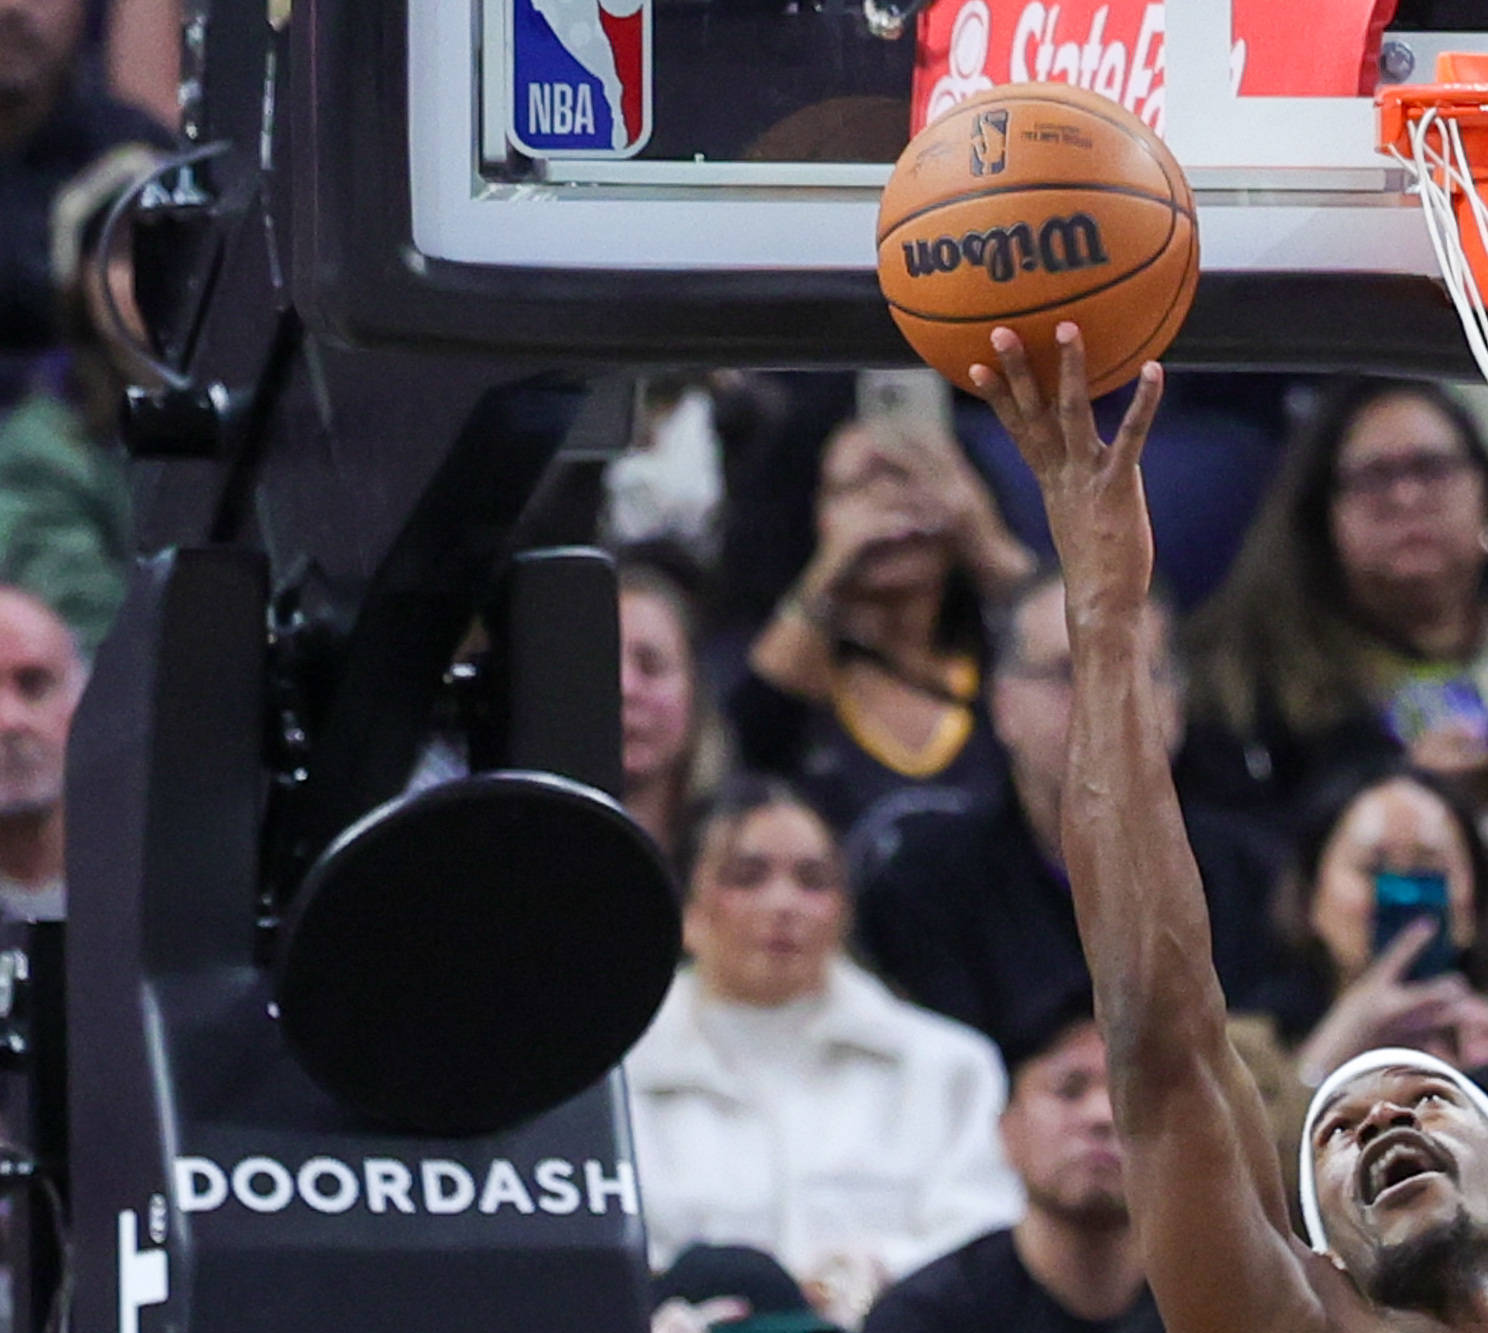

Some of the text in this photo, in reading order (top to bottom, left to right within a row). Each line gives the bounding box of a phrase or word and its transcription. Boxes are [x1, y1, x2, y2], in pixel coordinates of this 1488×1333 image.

[528, 82, 596, 135] NBA
[902, 212, 1109, 283] Wilson
[173, 1156, 638, 1215] DOORDASH
